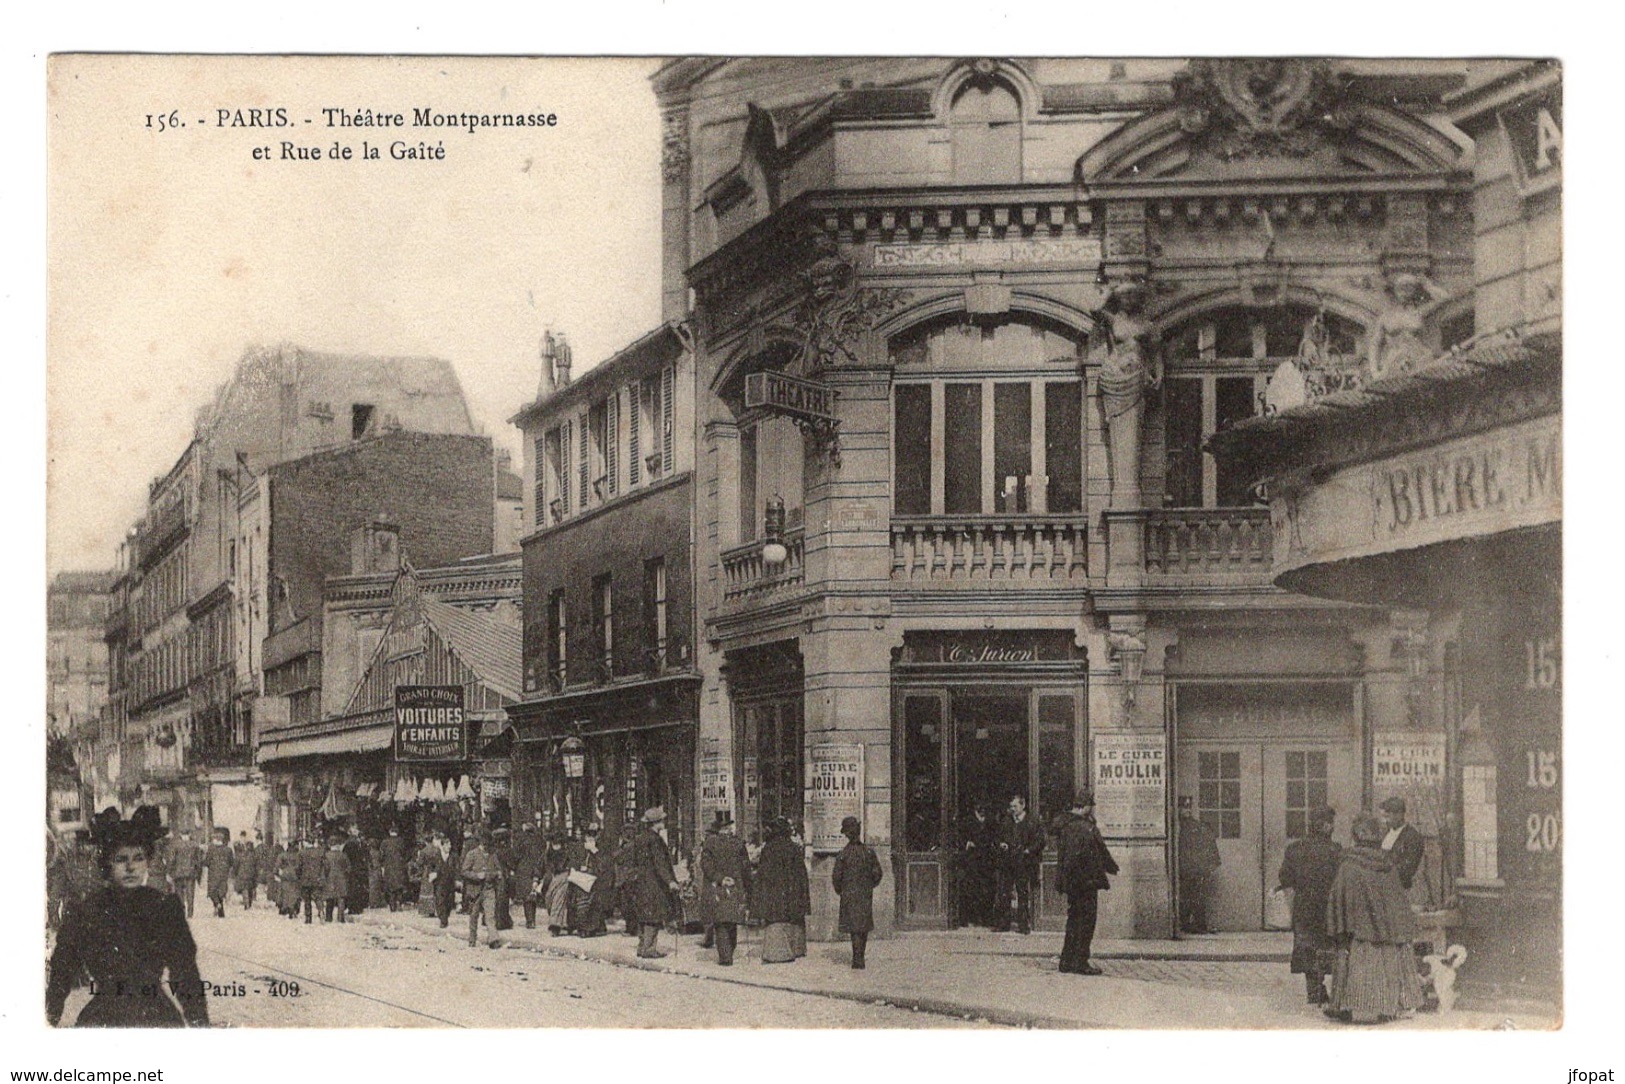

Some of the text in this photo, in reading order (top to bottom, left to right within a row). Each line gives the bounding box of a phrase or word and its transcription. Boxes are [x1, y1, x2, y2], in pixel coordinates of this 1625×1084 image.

[400, 689, 460, 703] GRAND CHOIX
[397, 707, 463, 725] VOITURES
[401, 727, 460, 742] d'ENFANTS
[1098, 751, 1117, 760] LE
[1099, 764, 1161, 779] MOULIN
[1377, 761, 1440, 776] MOULIN
